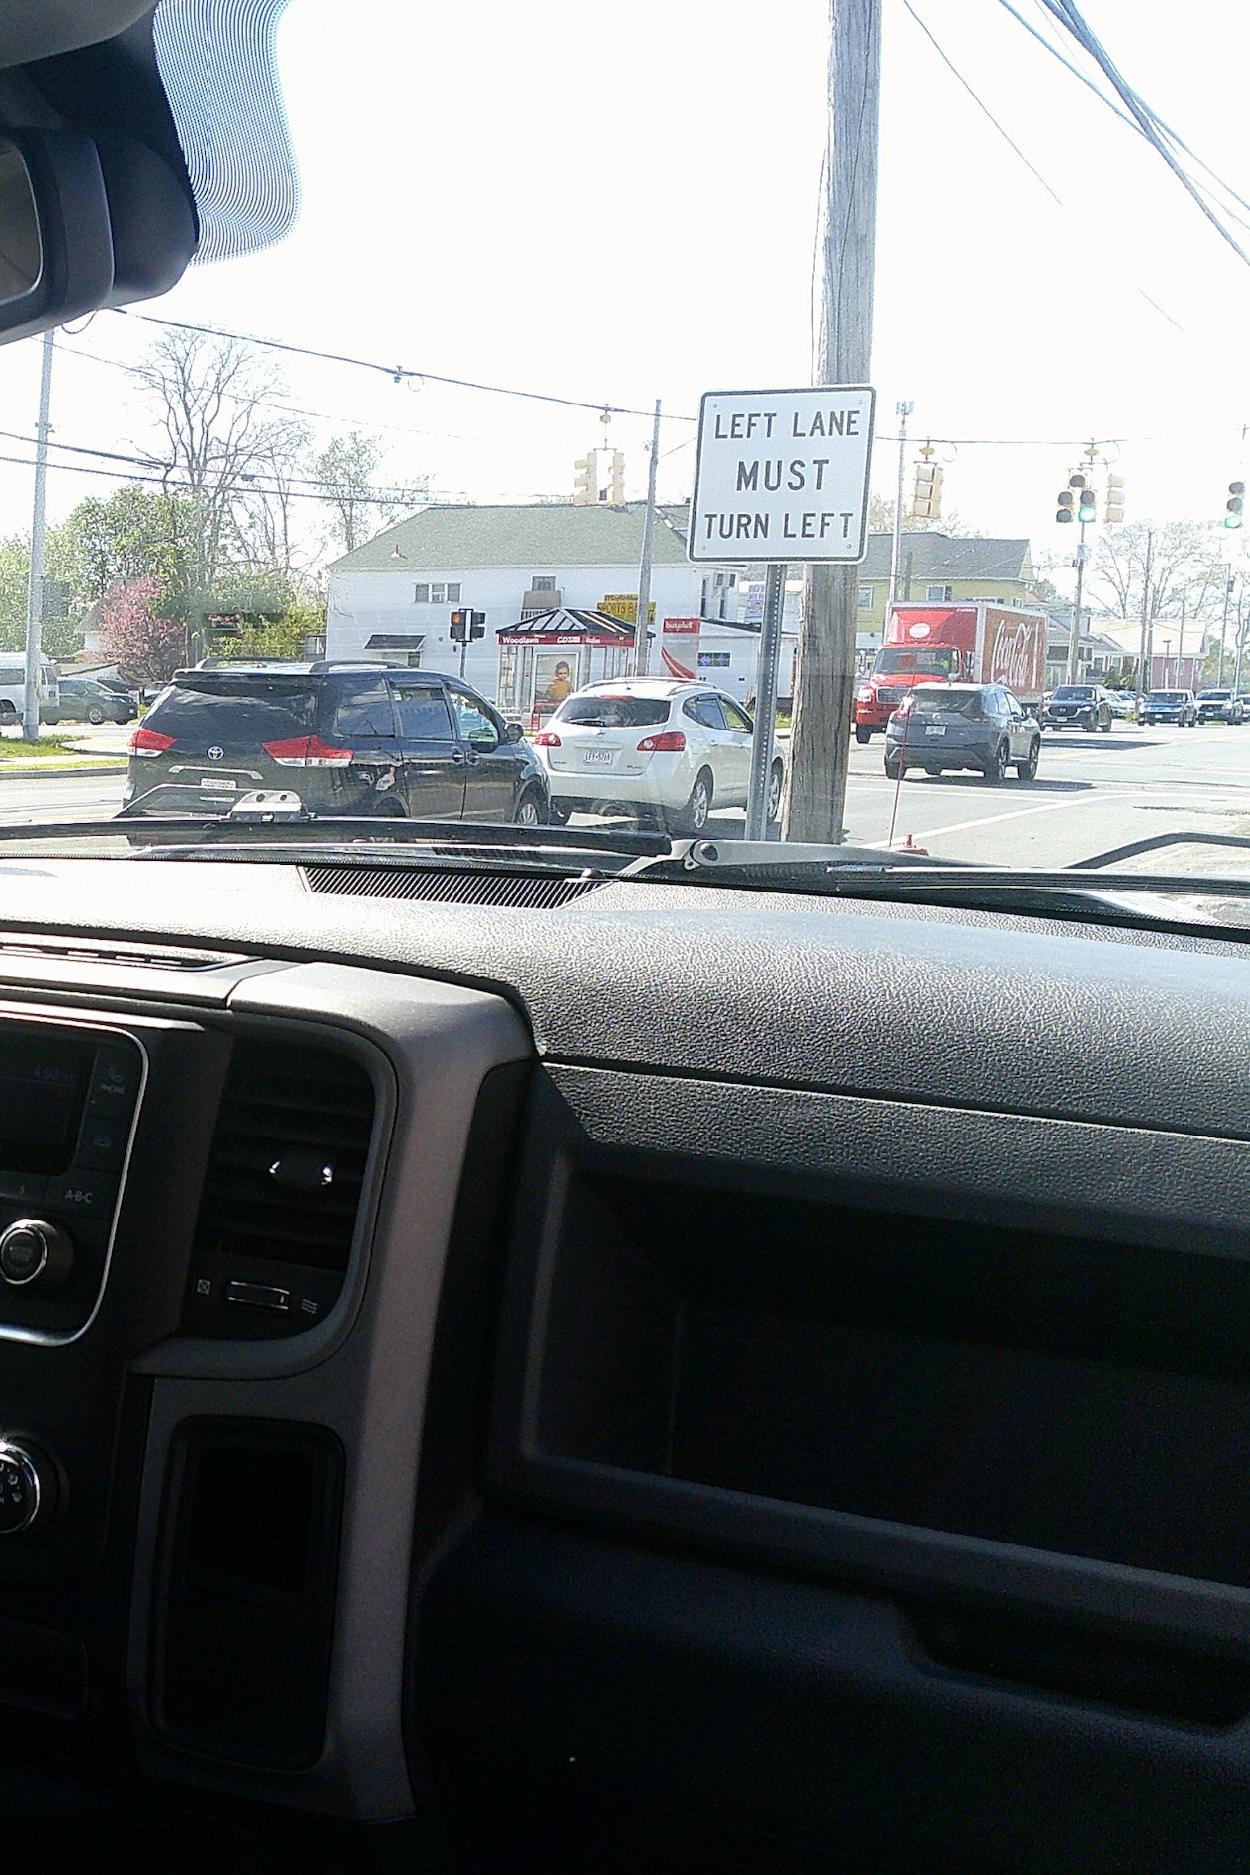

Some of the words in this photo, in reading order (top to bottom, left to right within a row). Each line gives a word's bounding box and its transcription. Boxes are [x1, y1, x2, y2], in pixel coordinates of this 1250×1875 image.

[714, 412, 777, 439] LEFT
[792, 410, 860, 438] LANE
[736, 459, 830, 491] MUST
[704, 513, 770, 539] TURN
[783, 512, 854, 539] LEFT
[502, 636, 540, 644] Woodlawn
